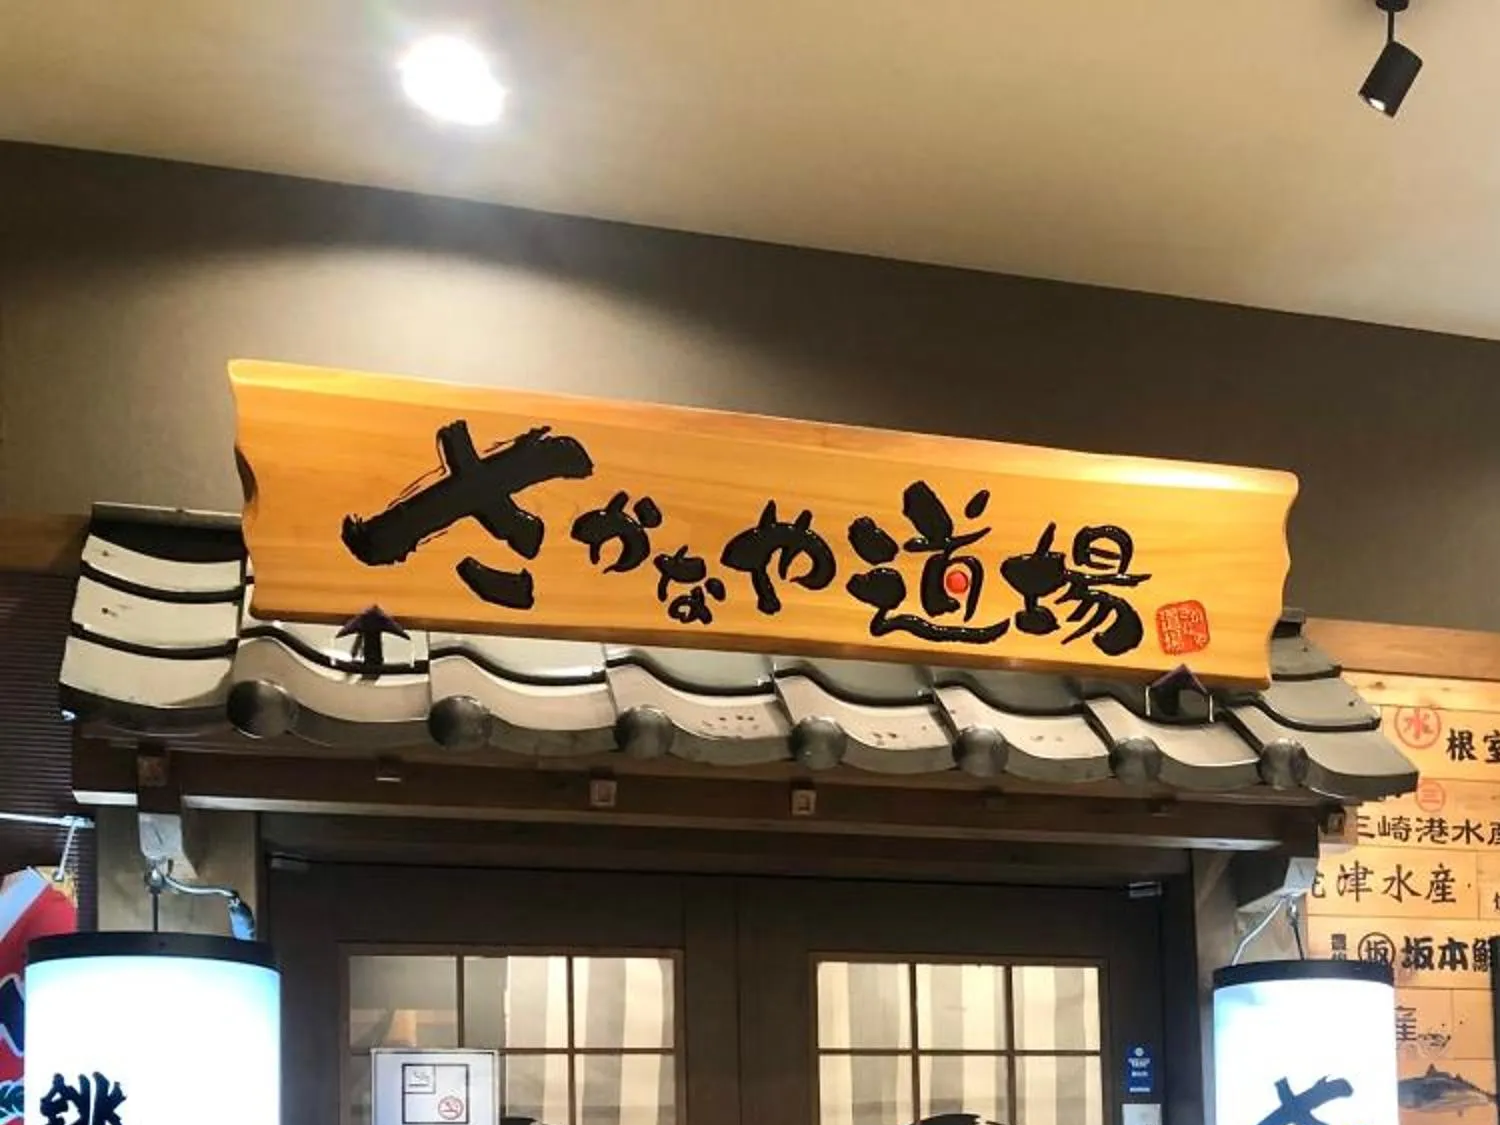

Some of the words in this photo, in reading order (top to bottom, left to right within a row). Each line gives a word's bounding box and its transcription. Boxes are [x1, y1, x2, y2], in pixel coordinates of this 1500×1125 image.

[341, 418, 1151, 656] さかなや道場
